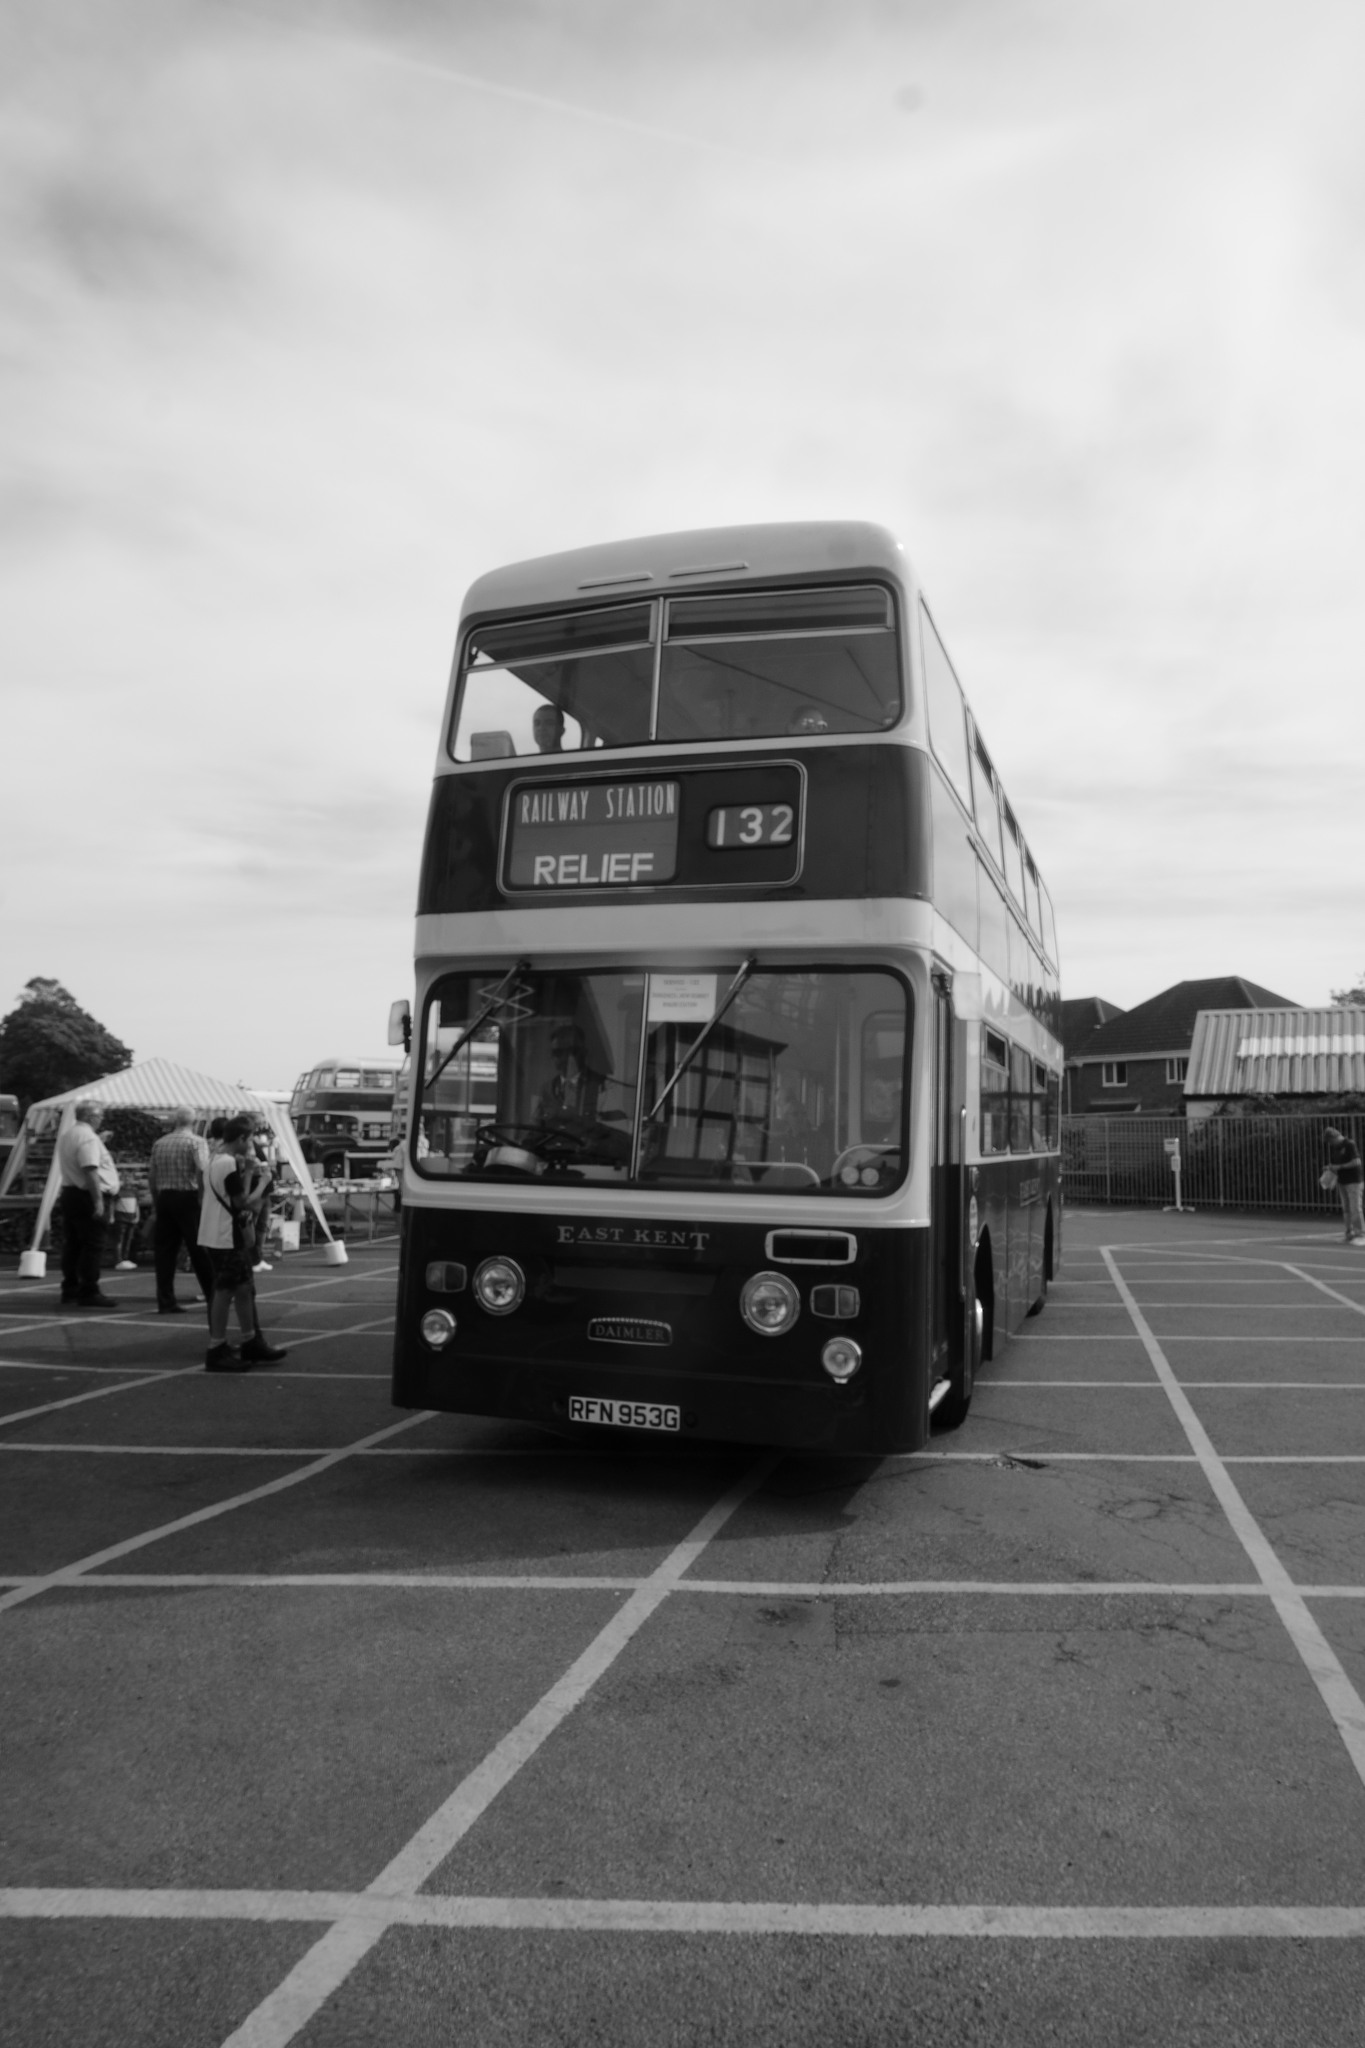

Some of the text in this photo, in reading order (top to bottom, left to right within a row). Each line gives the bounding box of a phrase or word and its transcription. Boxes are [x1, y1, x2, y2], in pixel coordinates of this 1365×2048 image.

[521, 784, 675, 823] RAILWAY STATION
[716, 805, 794, 846] 132
[533, 852, 654, 885] RELIEF
[557, 1225, 710, 1250] EAST KENT
[595, 1324, 665, 1341] DAIMLER
[570, 1399, 678, 1429] RFN 953G
